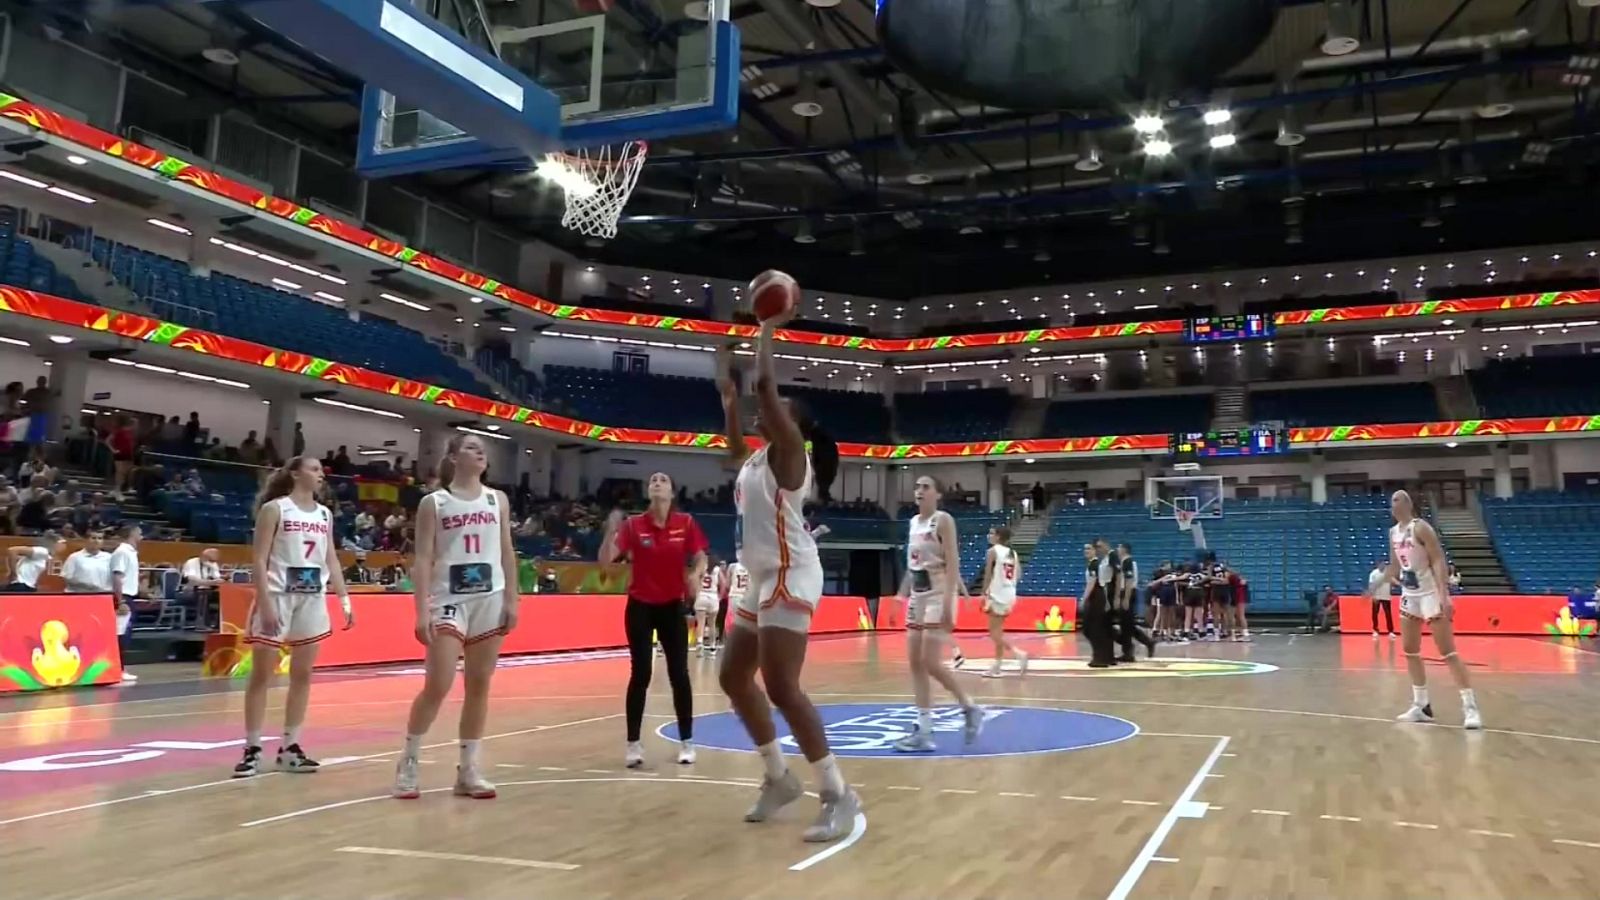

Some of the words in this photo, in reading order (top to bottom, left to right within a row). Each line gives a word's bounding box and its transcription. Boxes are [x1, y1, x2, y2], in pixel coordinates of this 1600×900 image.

[1187, 432, 1203, 440] ESP
[441, 511, 498, 530] ESPAÑA
[303, 540, 316, 560] 7
[463, 534, 480, 554] 11
